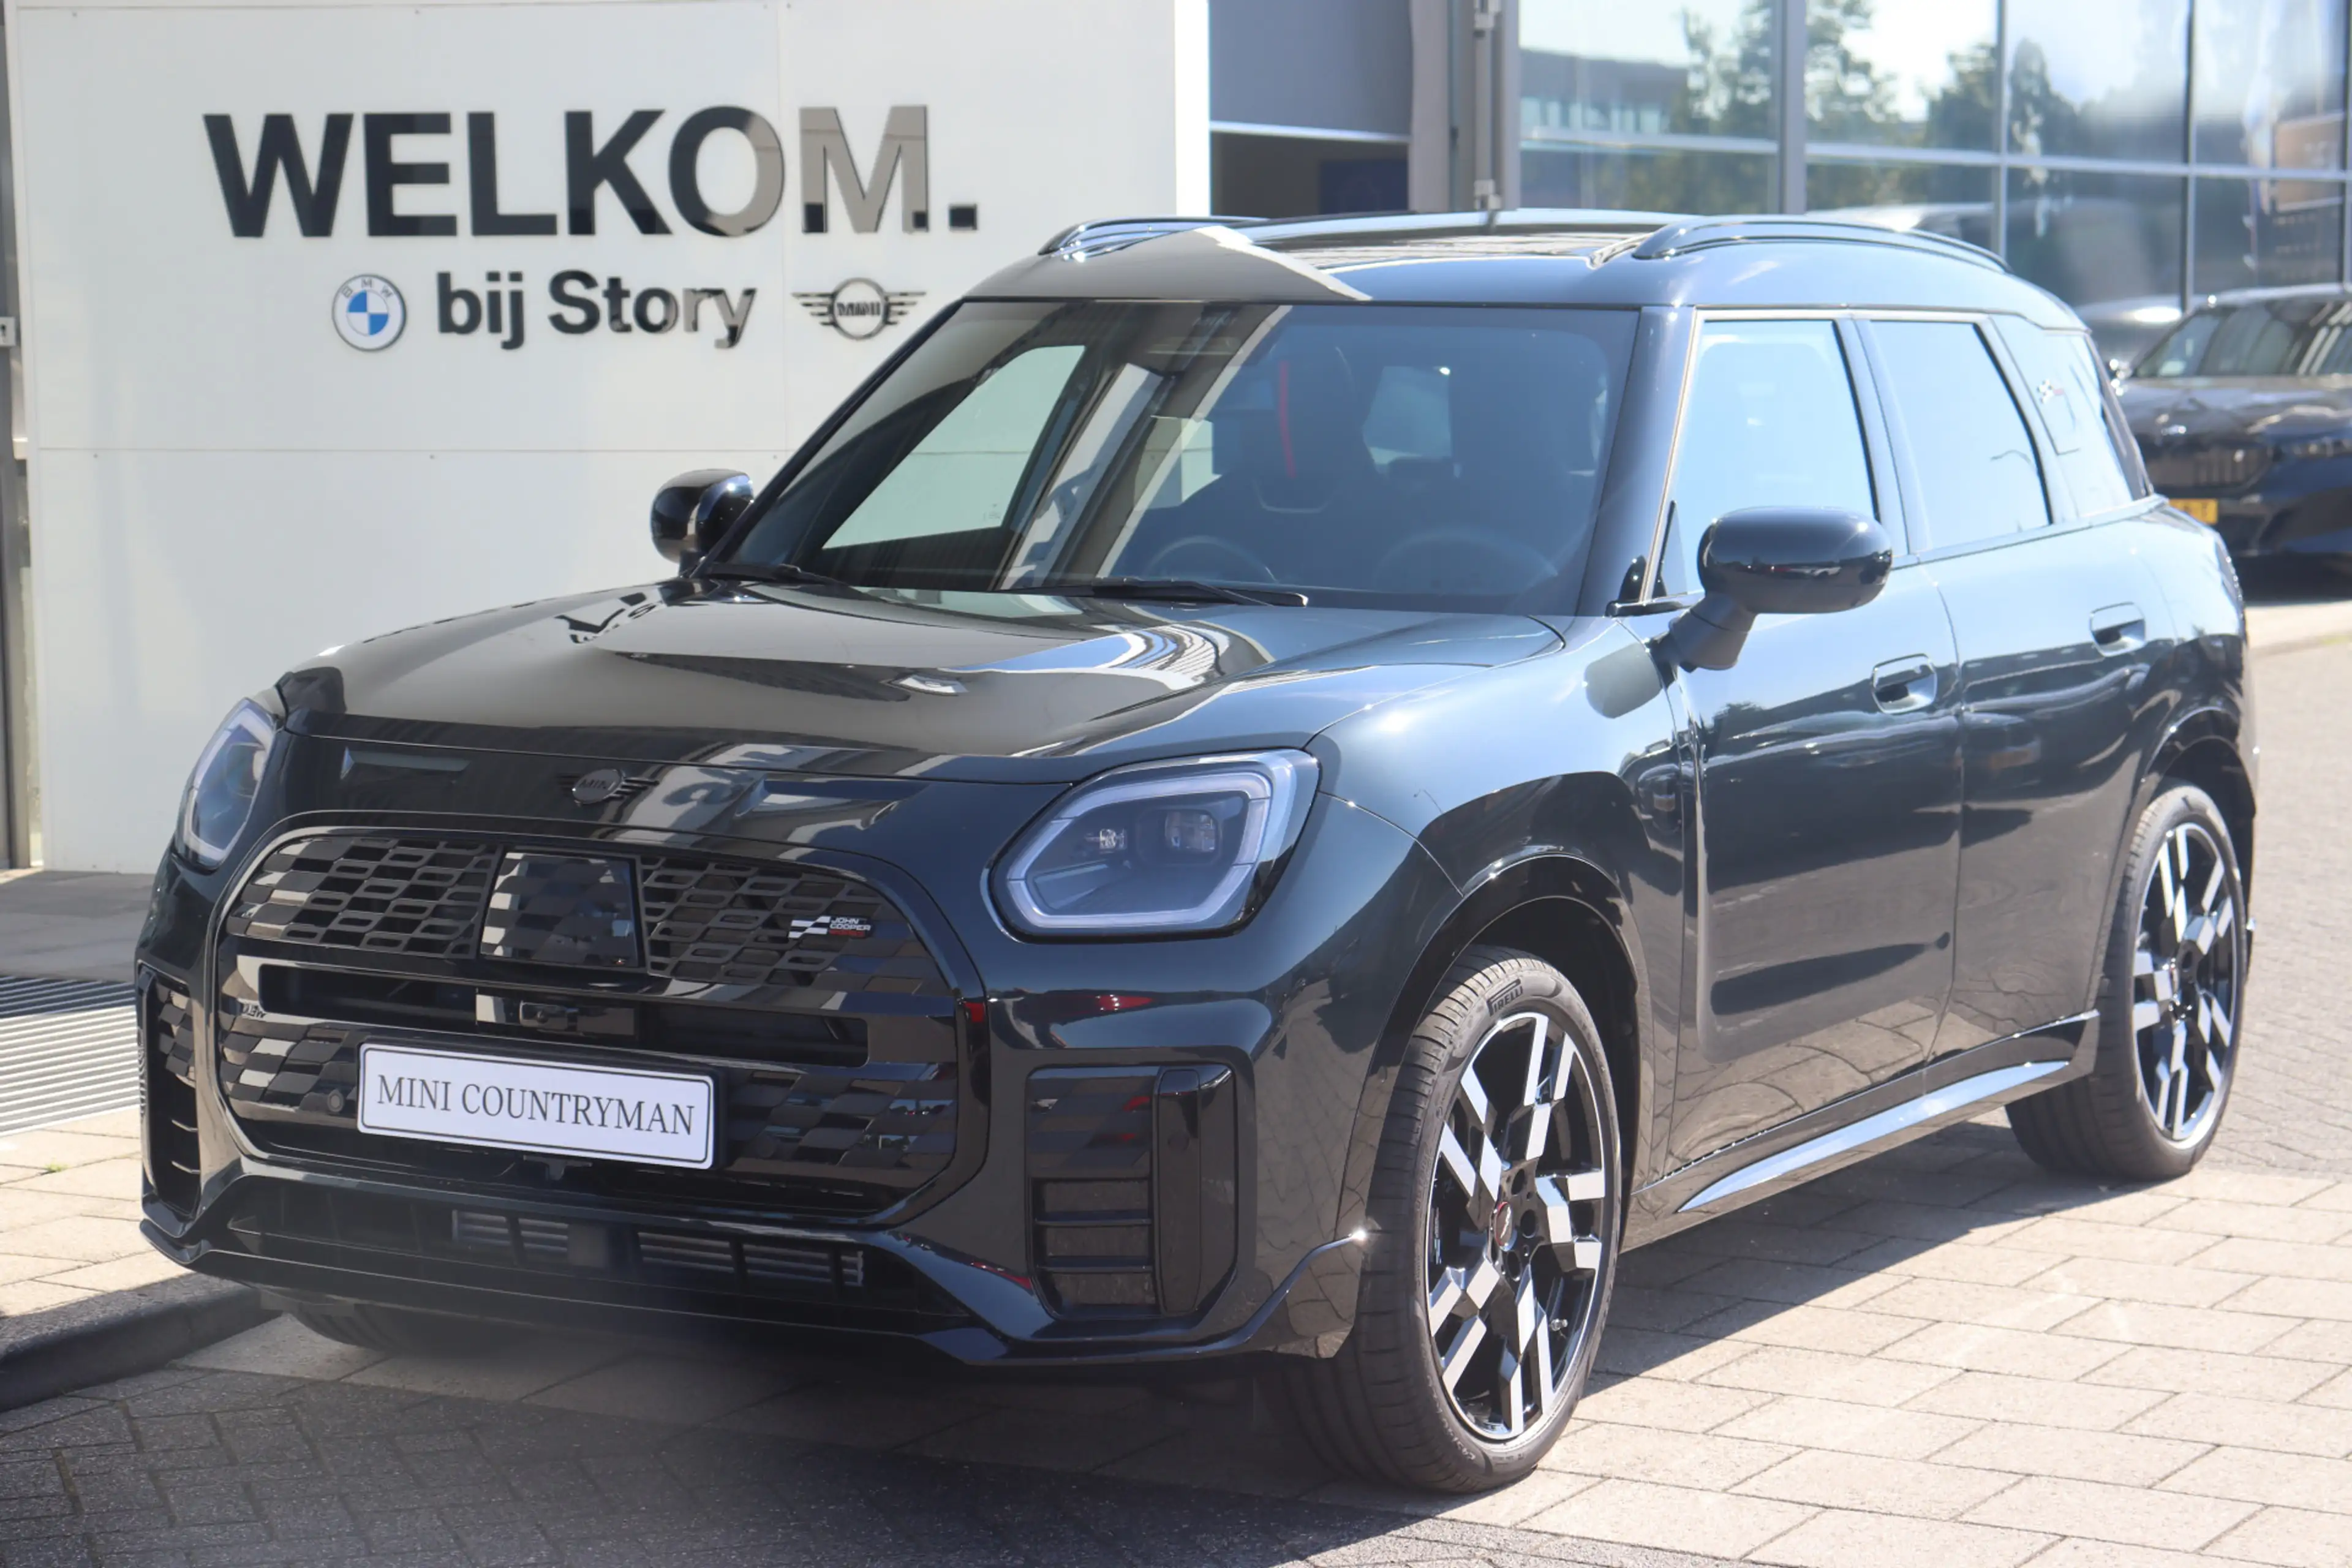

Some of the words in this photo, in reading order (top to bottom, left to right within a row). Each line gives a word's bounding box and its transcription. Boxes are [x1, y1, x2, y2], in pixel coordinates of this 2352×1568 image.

[202, 105, 978, 239] WELKOM.
[437, 270, 526, 352] bij
[548, 269, 758, 349] Story
[836, 301, 881, 316] MINI
[1487, 979, 1523, 1017] PIRELLI
[378, 1074, 452, 1111] MINI
[461, 1083, 695, 1136] COUNTRYMAN
